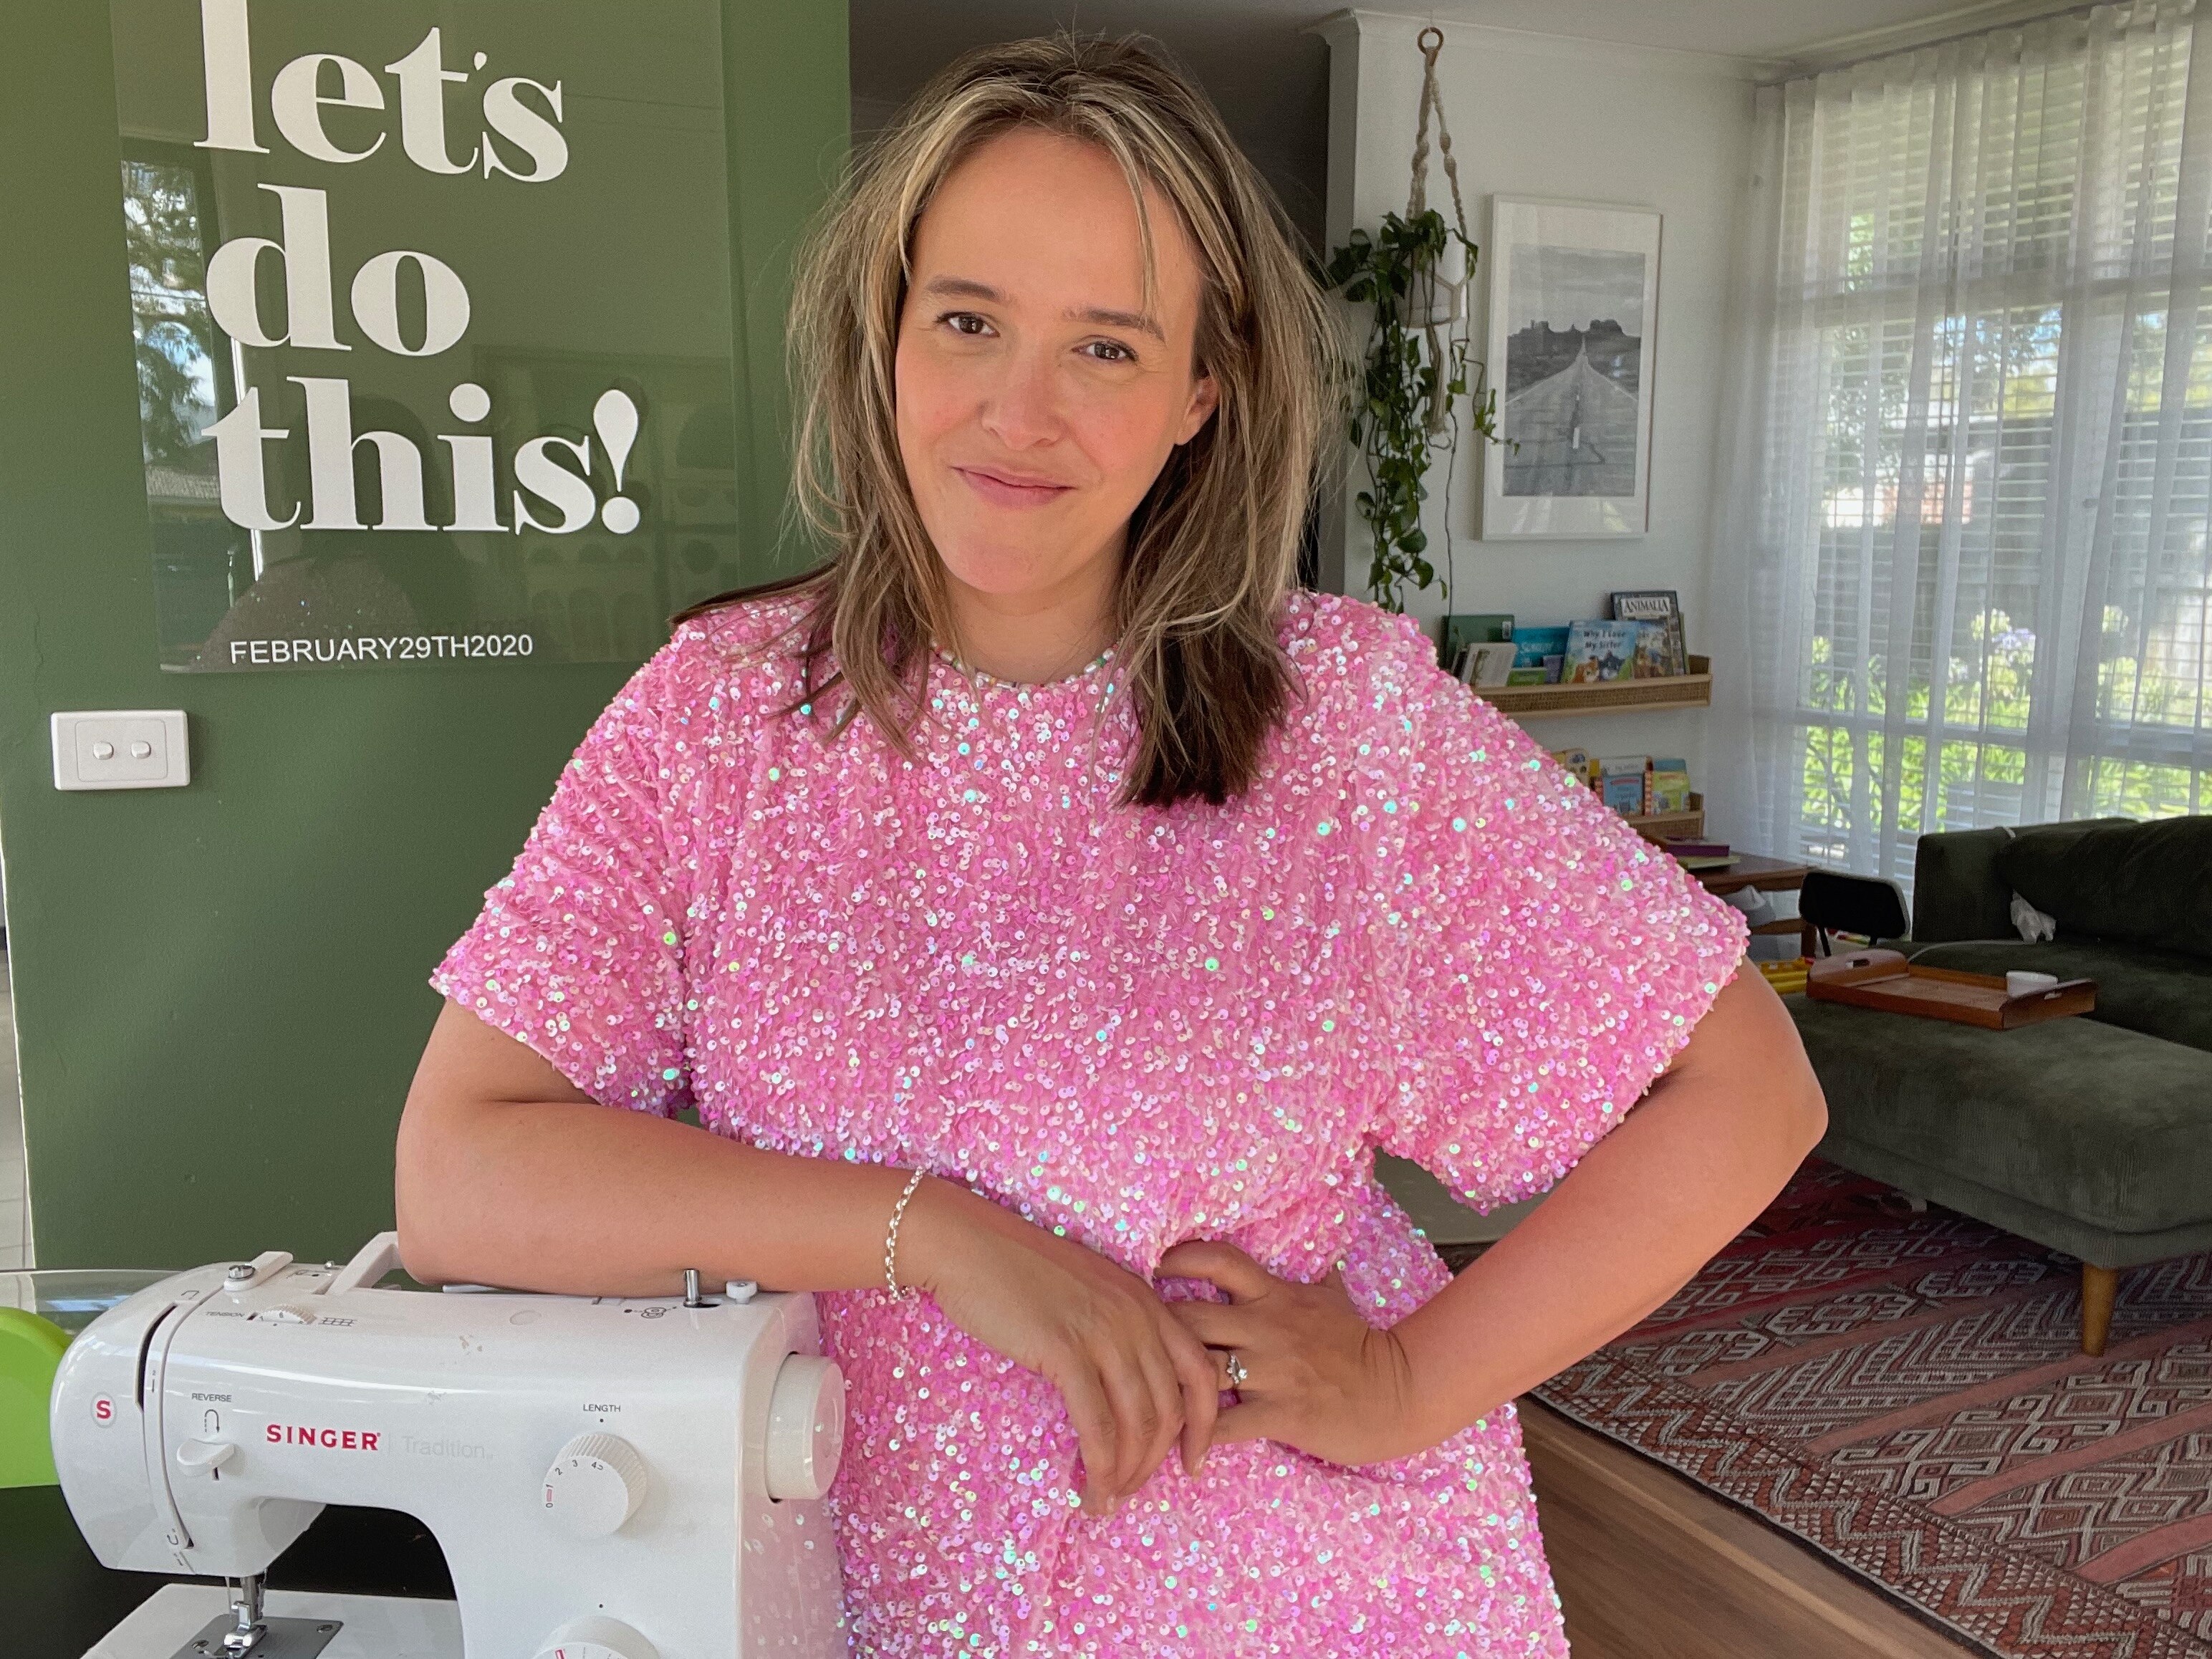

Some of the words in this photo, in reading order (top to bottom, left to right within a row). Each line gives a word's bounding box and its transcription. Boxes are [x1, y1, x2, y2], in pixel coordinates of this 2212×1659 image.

[193, 0, 569, 182] let's
[205, 183, 471, 357] do
[201, 376, 642, 535] this!
[229, 634, 534, 665] FEBRUARY29TH2020
[96, 1400, 111, 1419] S
[191, 1392, 233, 1403] REVERSE
[582, 1403, 621, 1413] LENGTH
